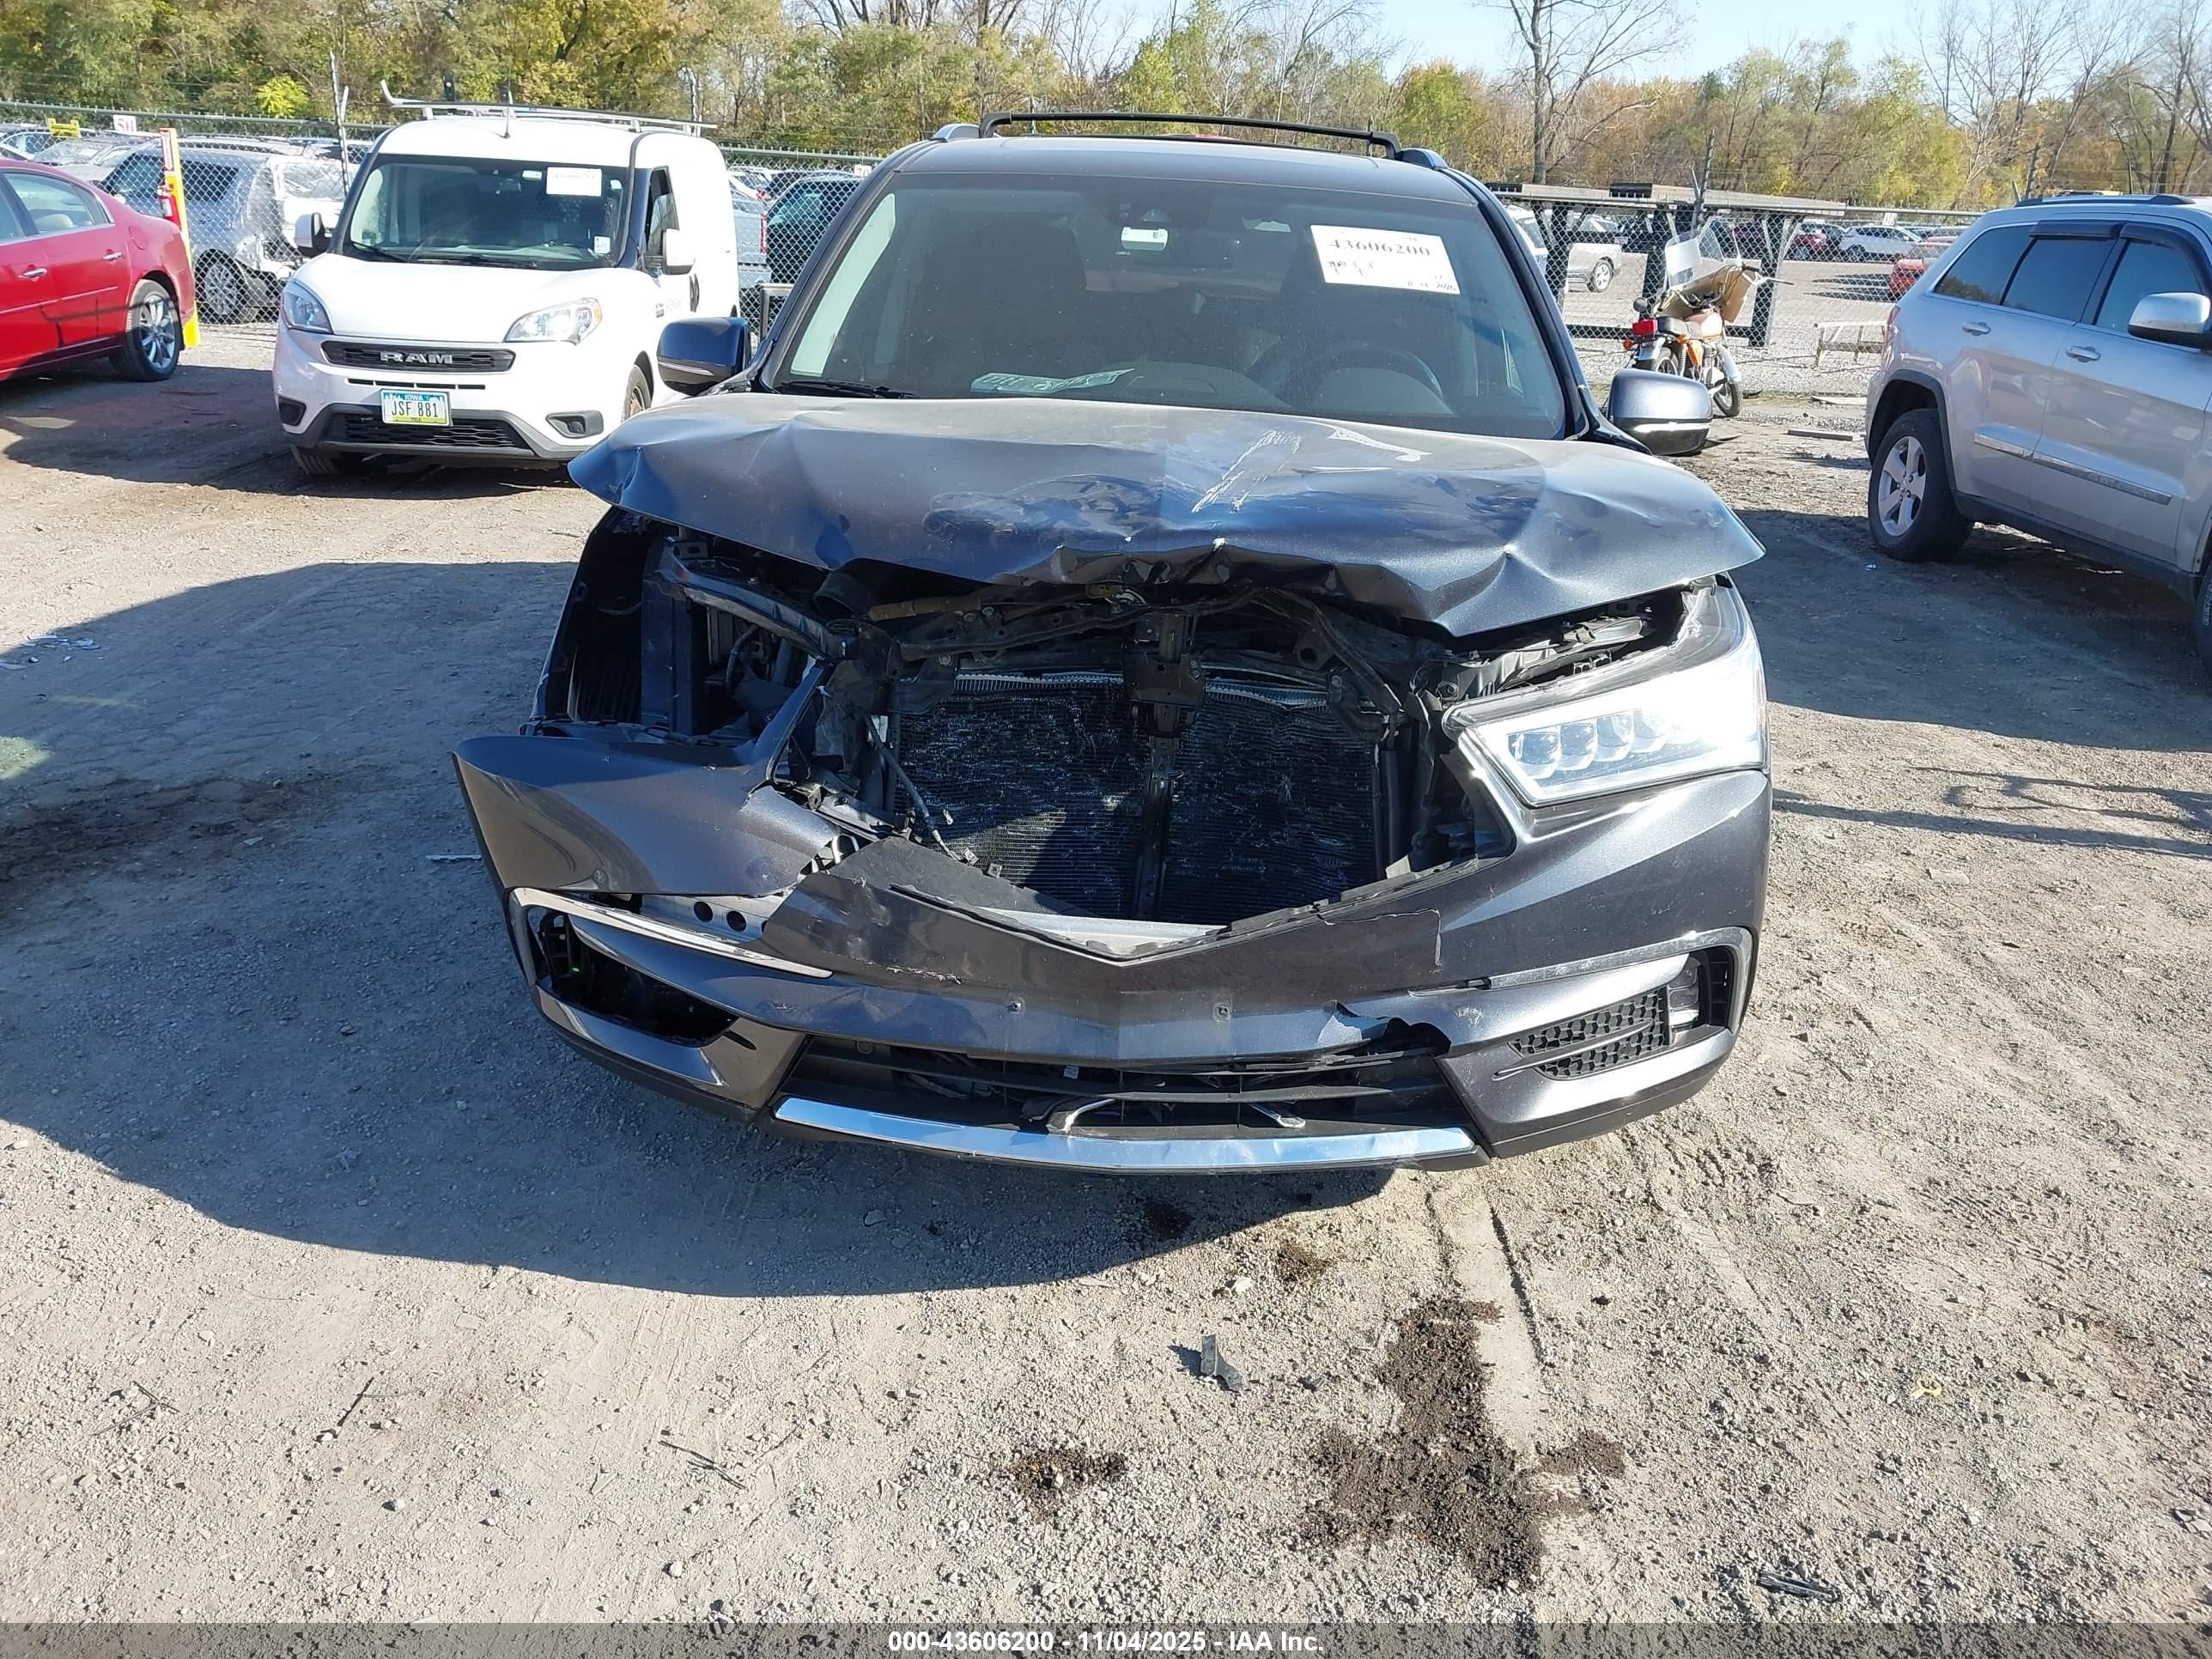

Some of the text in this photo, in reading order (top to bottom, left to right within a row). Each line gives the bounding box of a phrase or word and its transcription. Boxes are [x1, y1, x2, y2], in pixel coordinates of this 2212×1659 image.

[1329, 238, 1431, 256] 43606200
[380, 351, 453, 364] RAM
[392, 400, 439, 418] JSF 881
